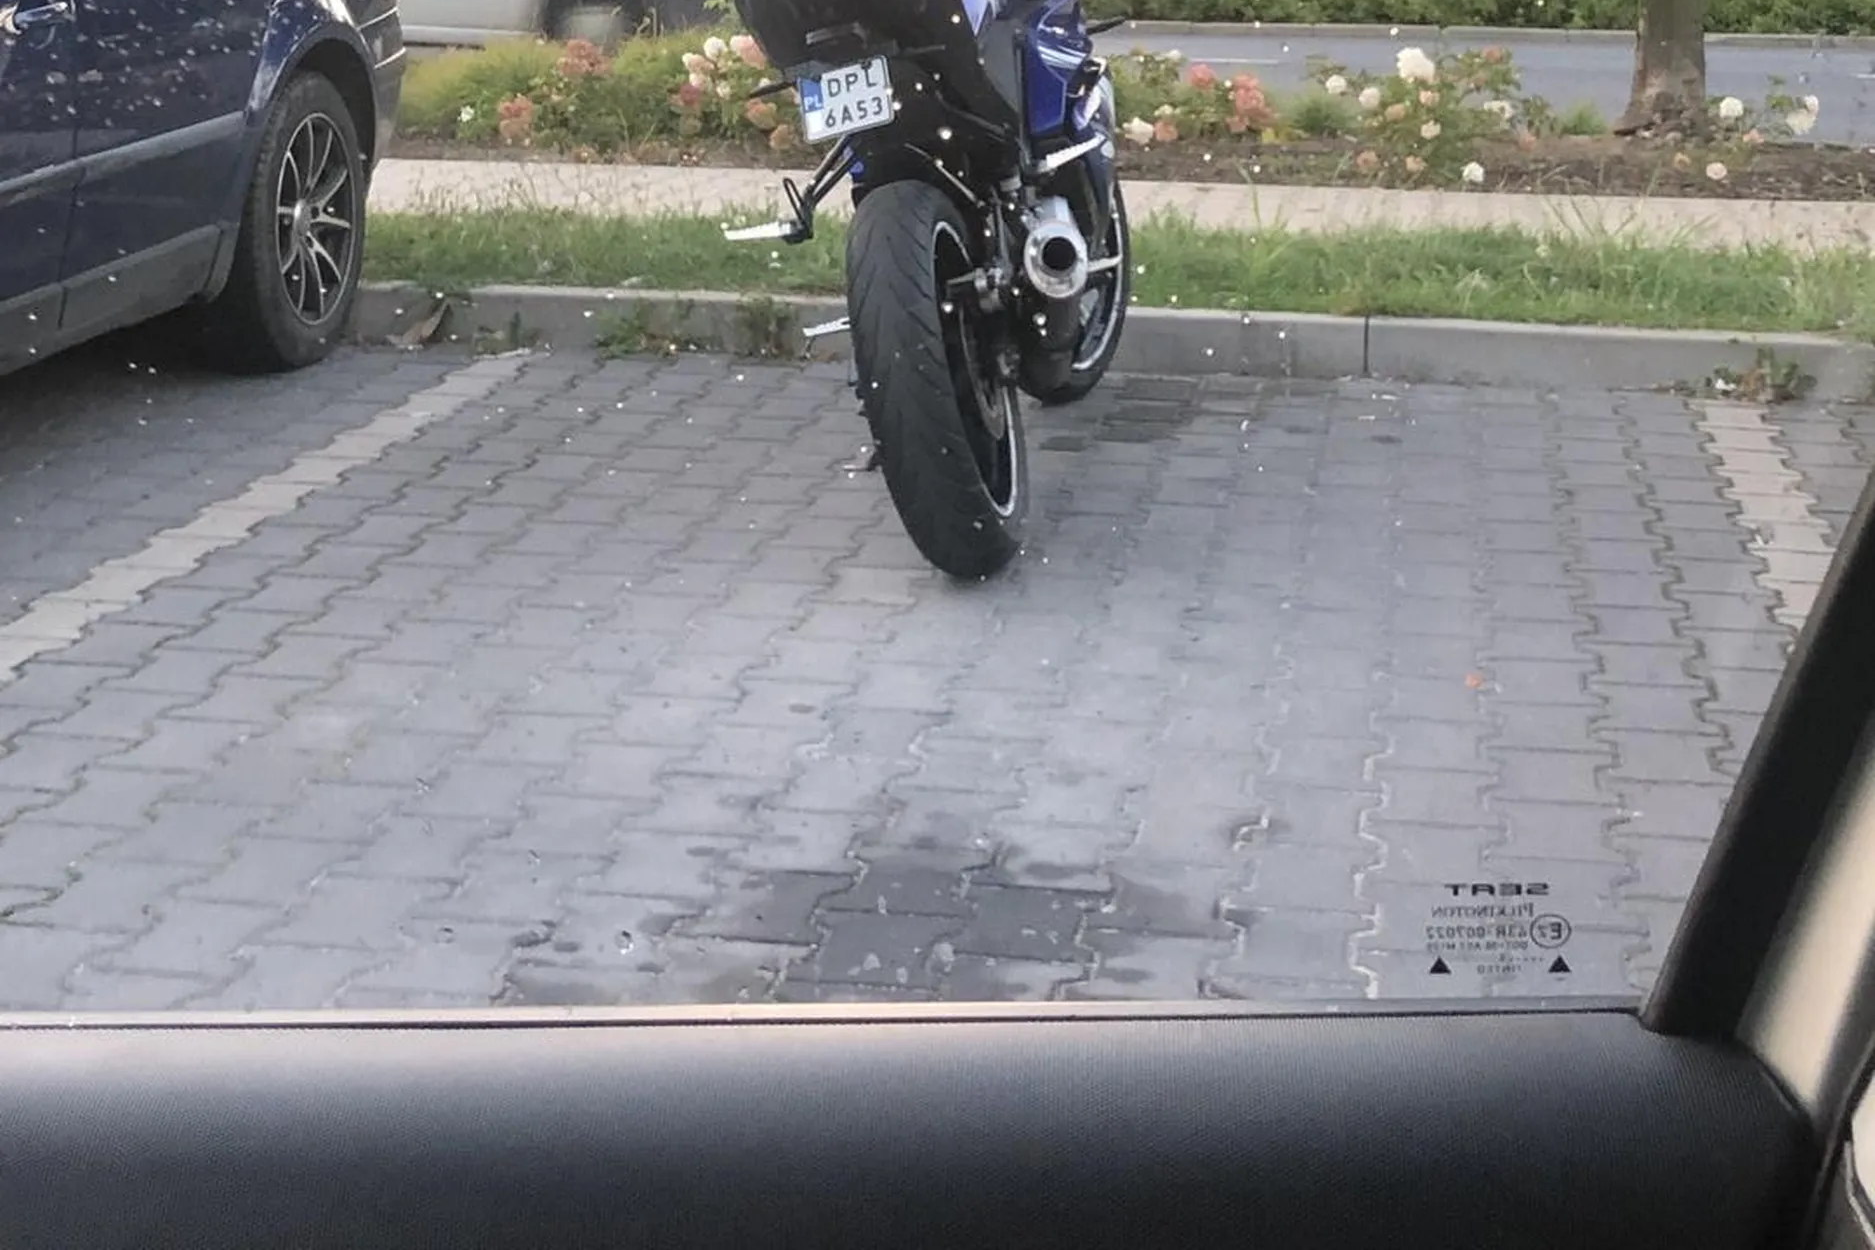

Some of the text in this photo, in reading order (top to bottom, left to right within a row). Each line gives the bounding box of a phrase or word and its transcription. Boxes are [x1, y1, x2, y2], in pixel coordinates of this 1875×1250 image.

[828, 64, 877, 97] DPL
[804, 93, 822, 110] PL
[825, 97, 882, 127] 6A53
